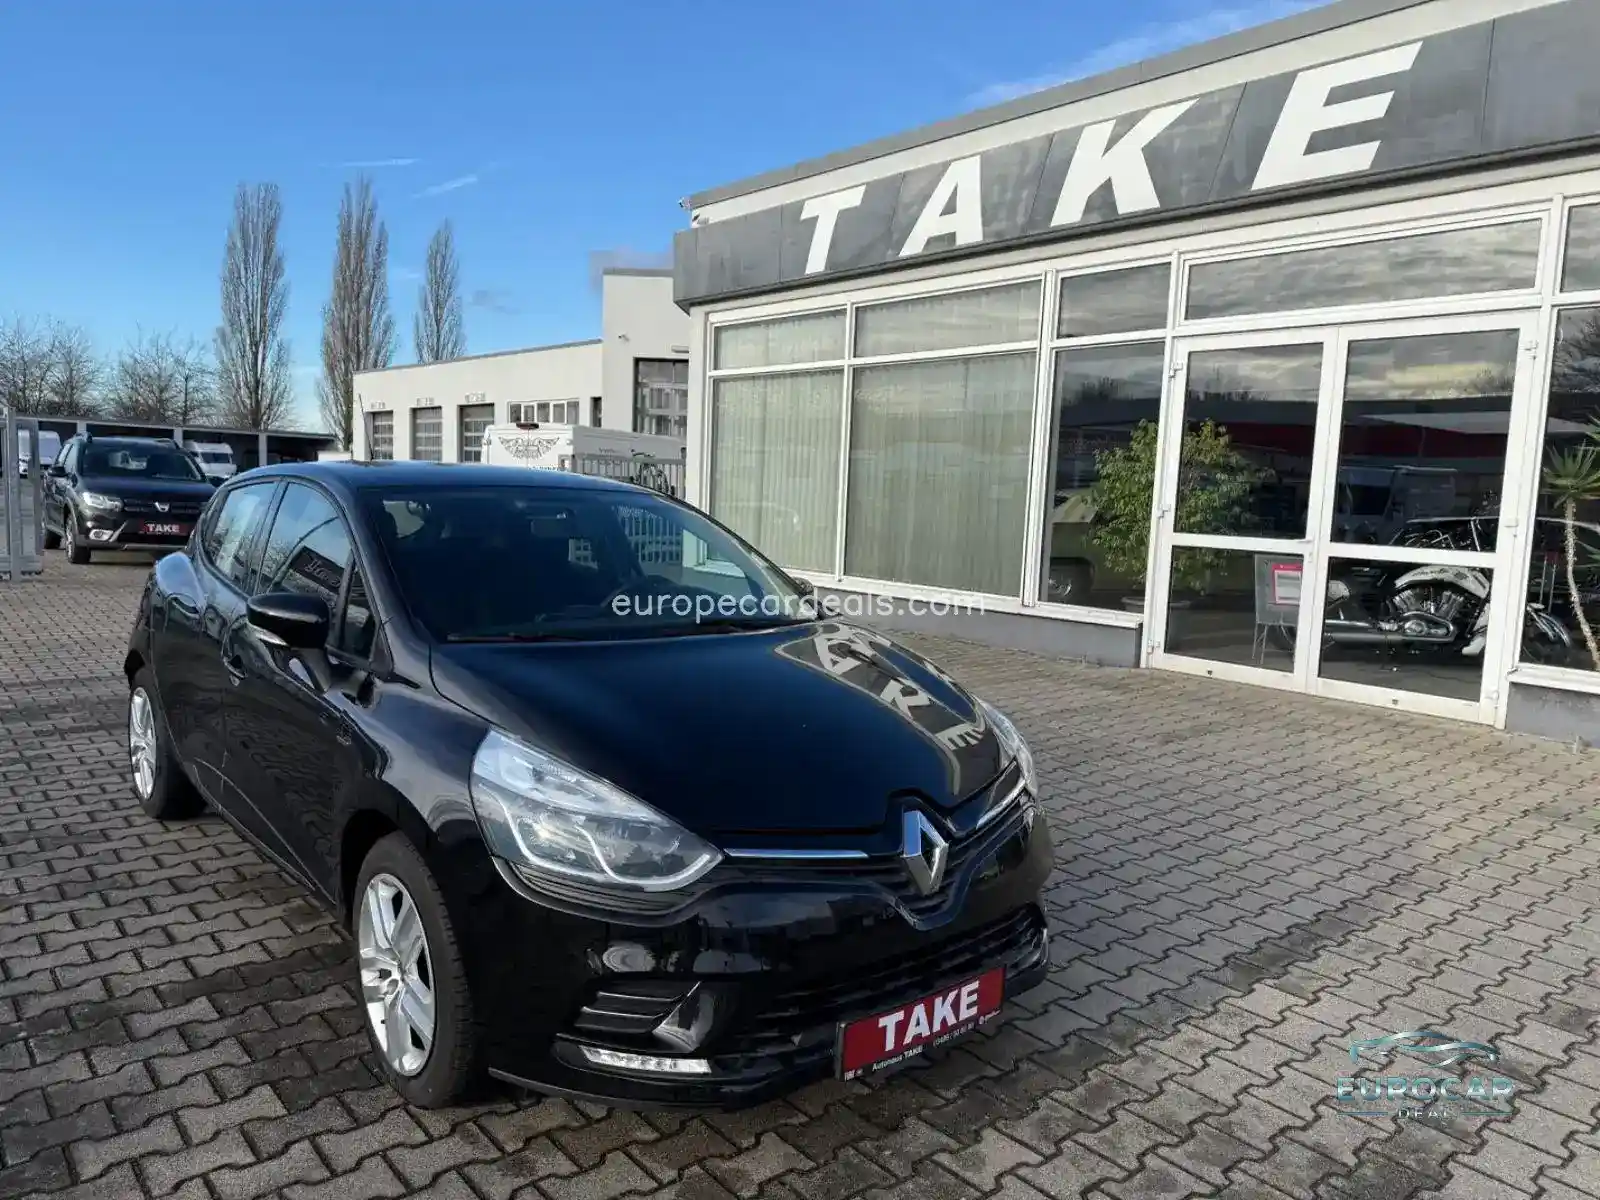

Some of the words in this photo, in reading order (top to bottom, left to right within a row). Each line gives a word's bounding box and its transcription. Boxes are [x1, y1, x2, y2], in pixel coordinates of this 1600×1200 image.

[800, 41, 1423, 275] TAKE
[146, 523, 181, 533] TAKE
[878, 979, 981, 1052] TAKE
